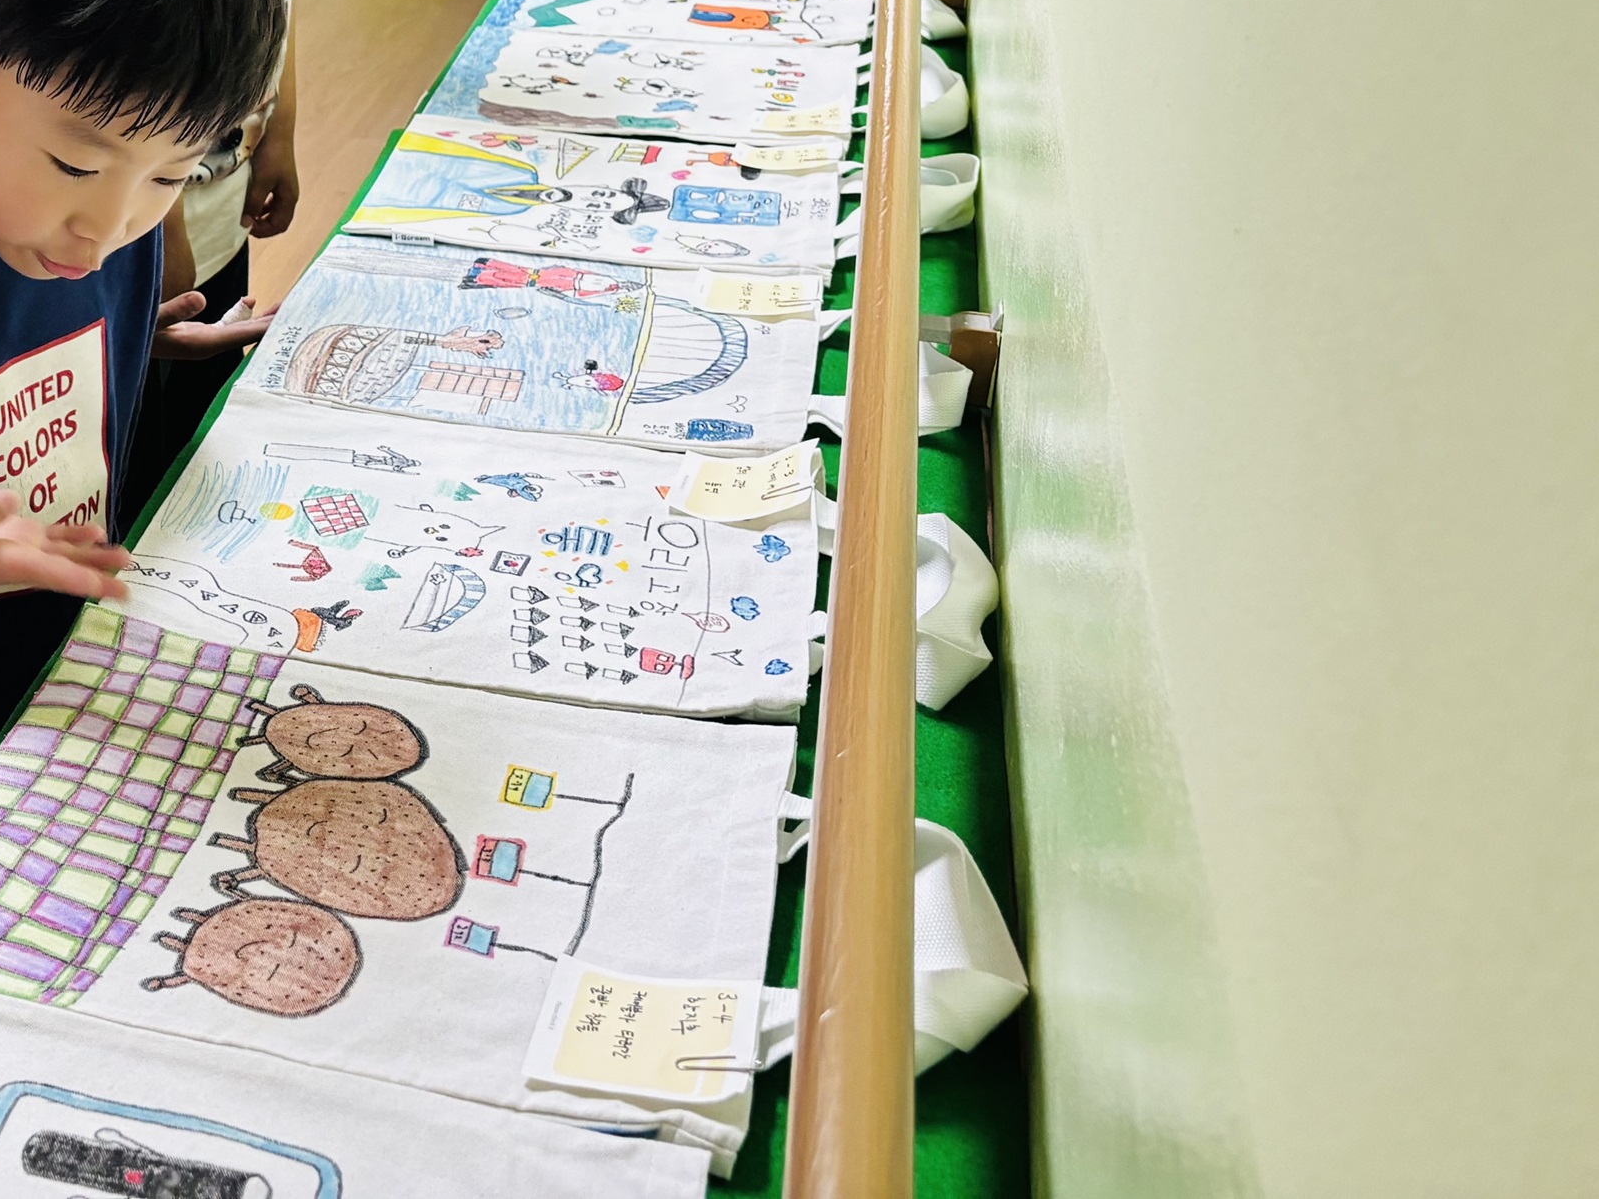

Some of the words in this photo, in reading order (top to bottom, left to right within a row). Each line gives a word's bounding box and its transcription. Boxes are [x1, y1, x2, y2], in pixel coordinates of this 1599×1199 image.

[28, 471, 58, 513] OF
[589, 984, 613, 1007] 꿀빵
[618, 990, 648, 1023] 케이블카
[713, 992, 738, 1024] 3-4
[576, 1013, 606, 1033] 친구들
